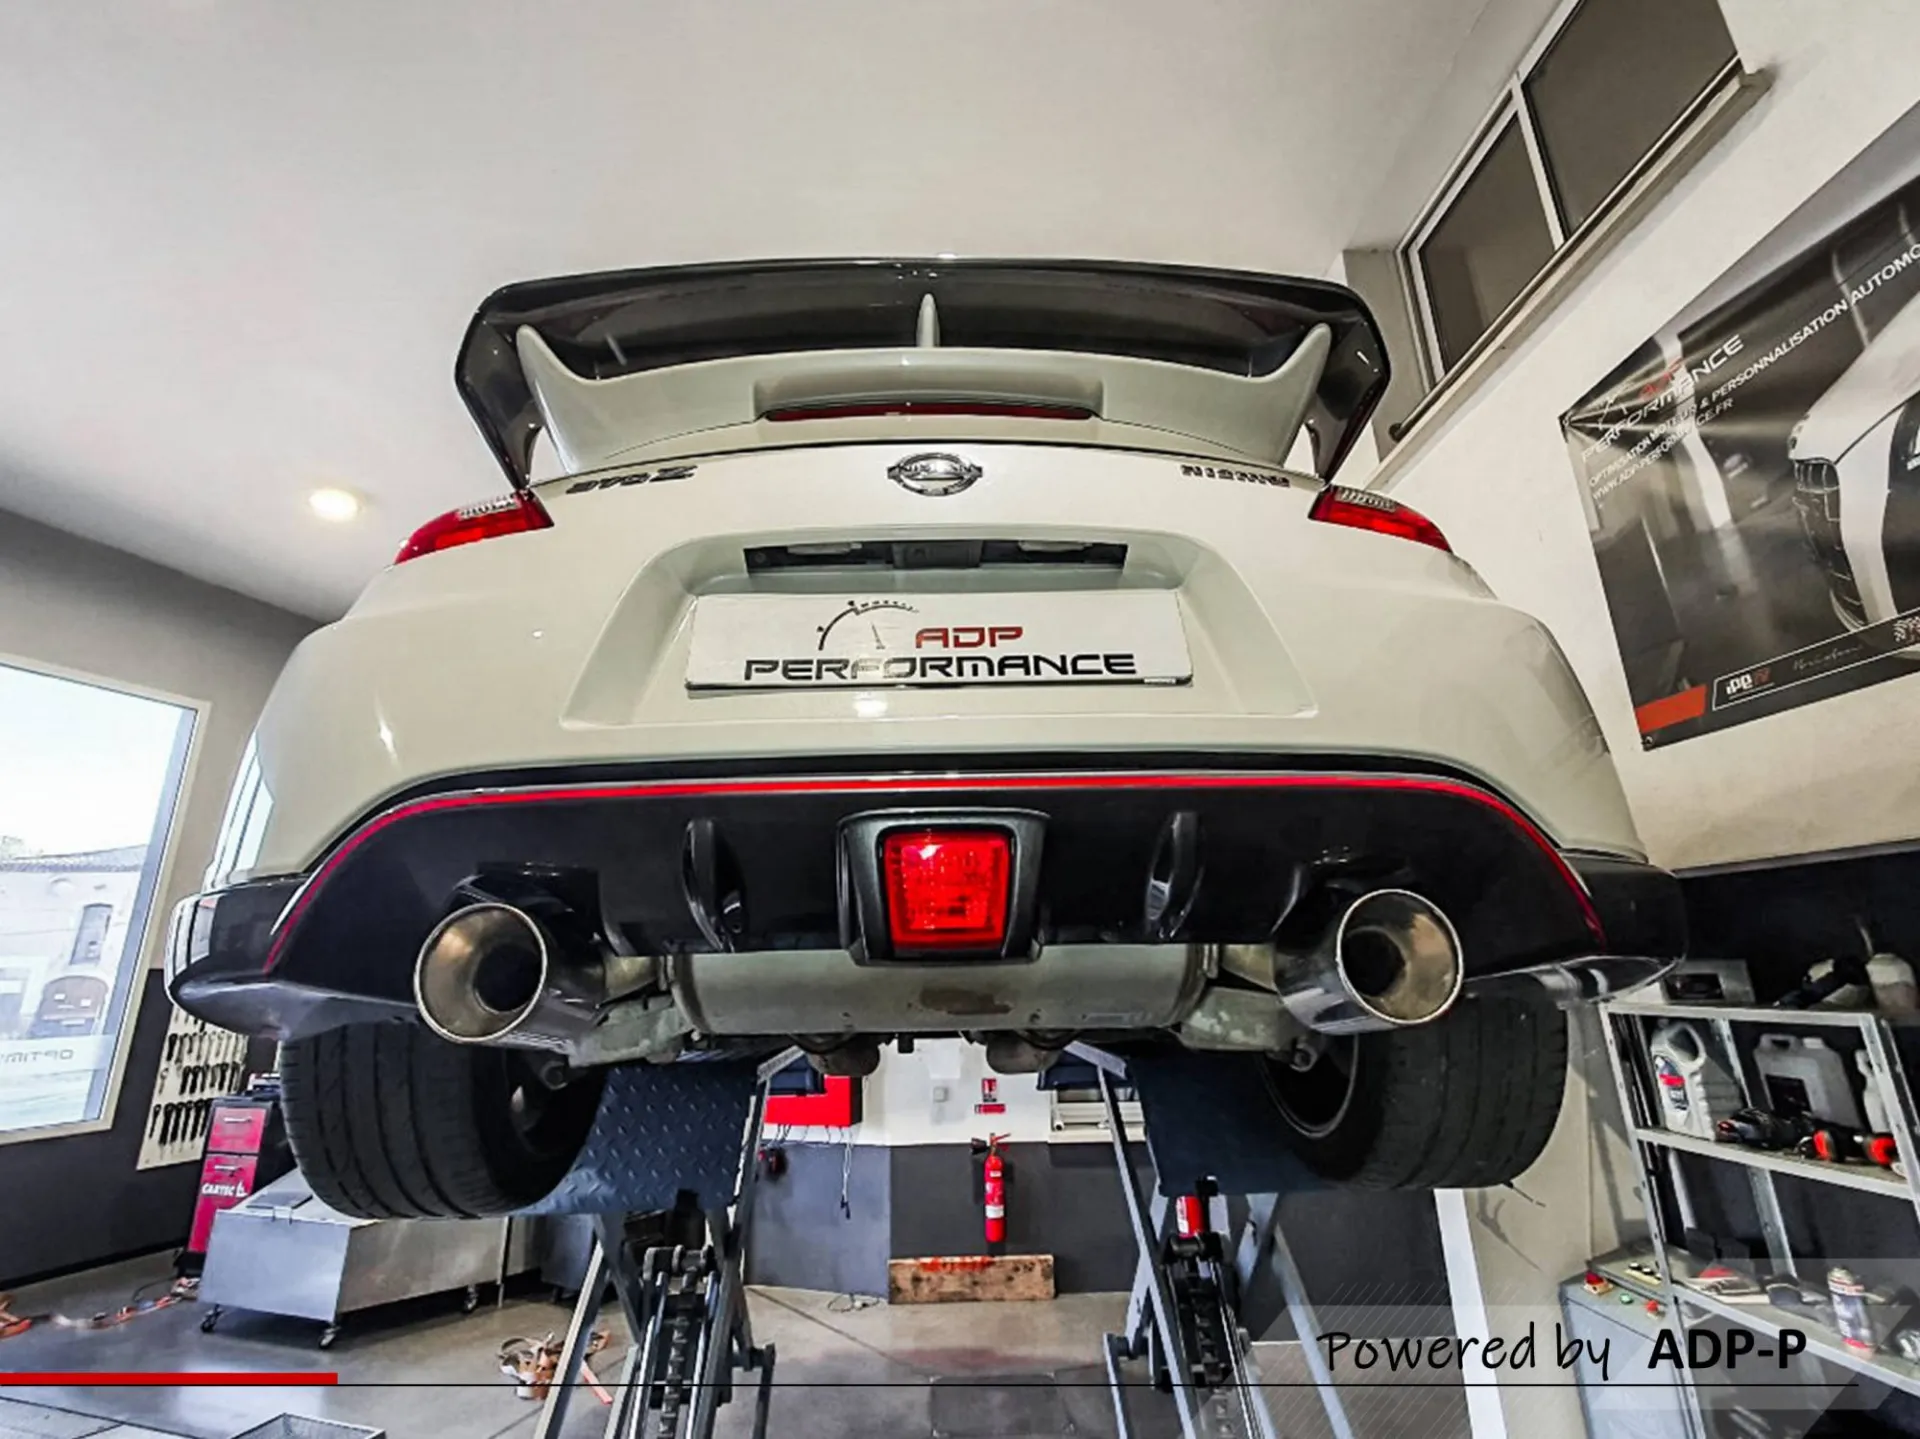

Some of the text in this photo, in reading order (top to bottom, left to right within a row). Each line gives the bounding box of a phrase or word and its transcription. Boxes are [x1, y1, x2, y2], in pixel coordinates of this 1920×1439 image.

[1711, 299, 1849, 402] PERSONNALISATION
[915, 626, 1023, 649] ADP
[744, 652, 1137, 682] PERFORMANCE
